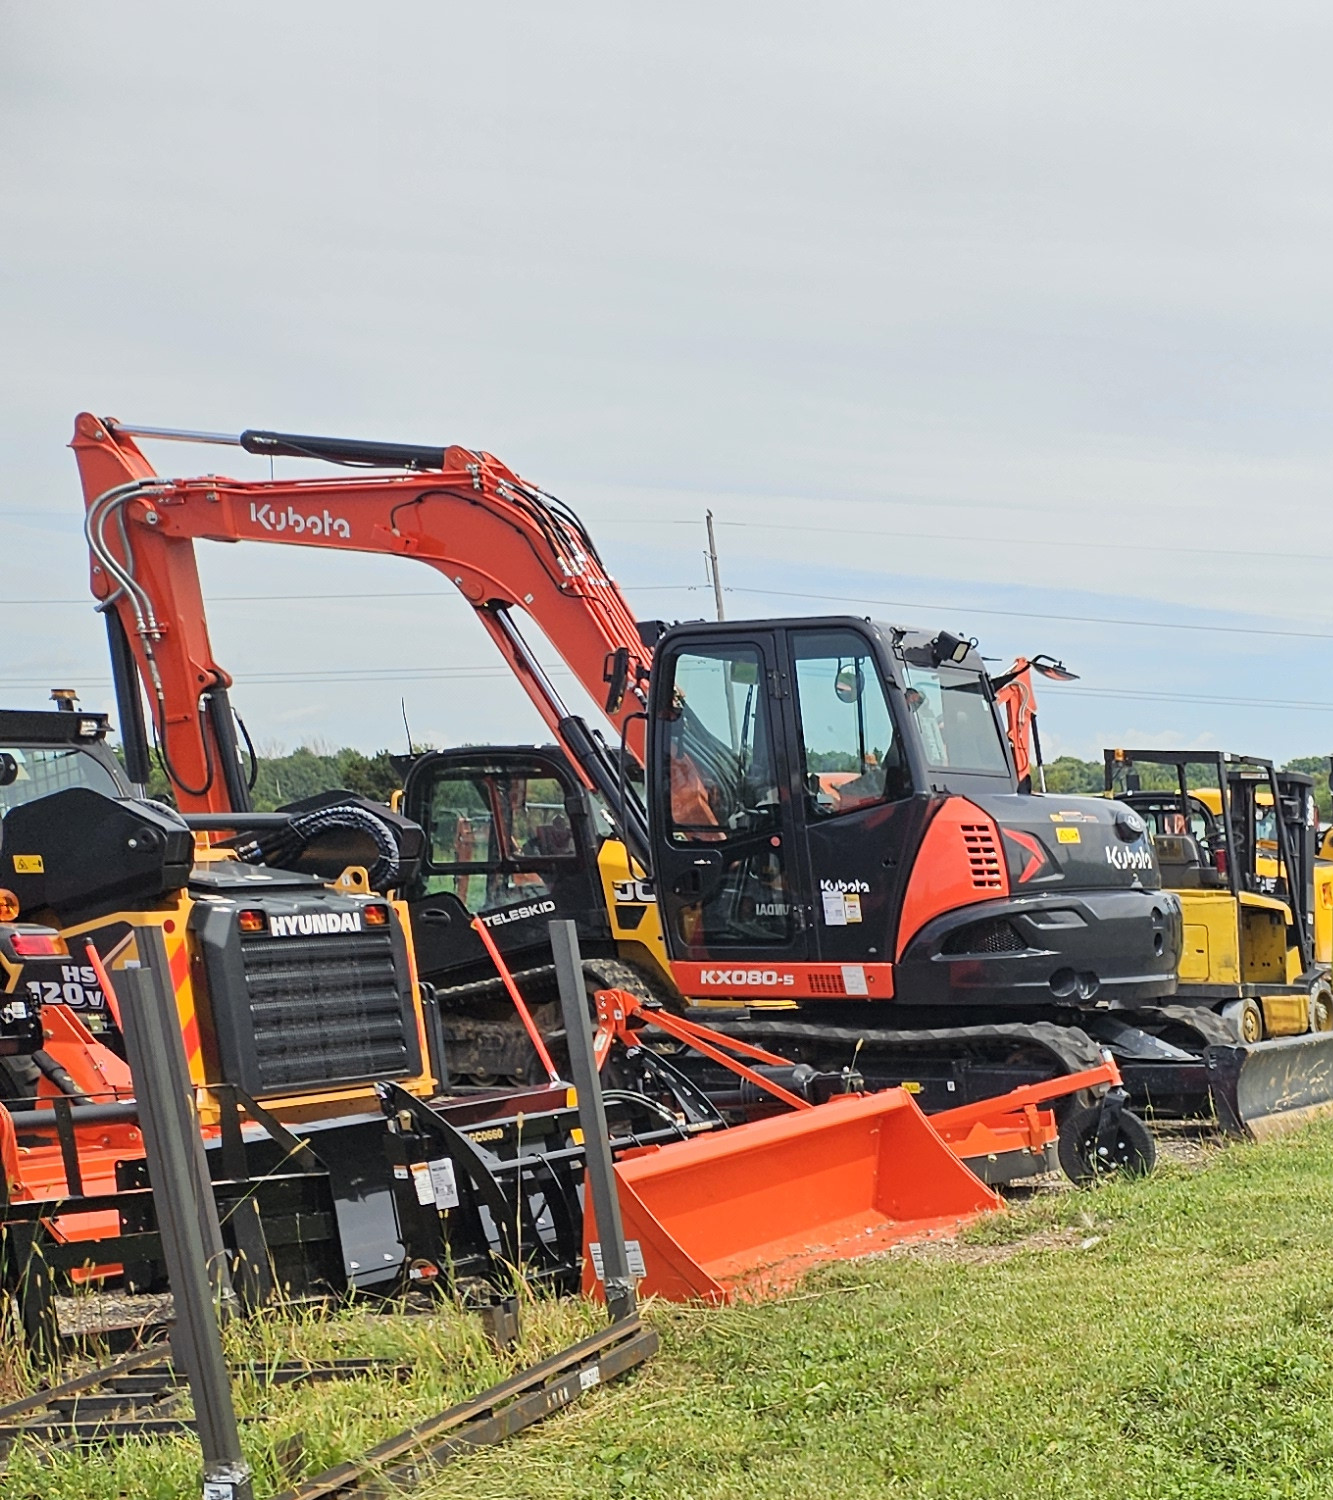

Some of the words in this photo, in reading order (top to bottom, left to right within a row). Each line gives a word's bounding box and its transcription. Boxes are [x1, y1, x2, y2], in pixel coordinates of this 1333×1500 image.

[250, 502, 350, 538] Kubota
[1105, 845, 1152, 869] Kubota
[612, 880, 657, 901] JC
[820, 879, 870, 893] Kubota
[270, 912, 361, 937] HYUNDAI
[483, 901, 555, 927] TELESKID
[61, 965, 98, 985] HS
